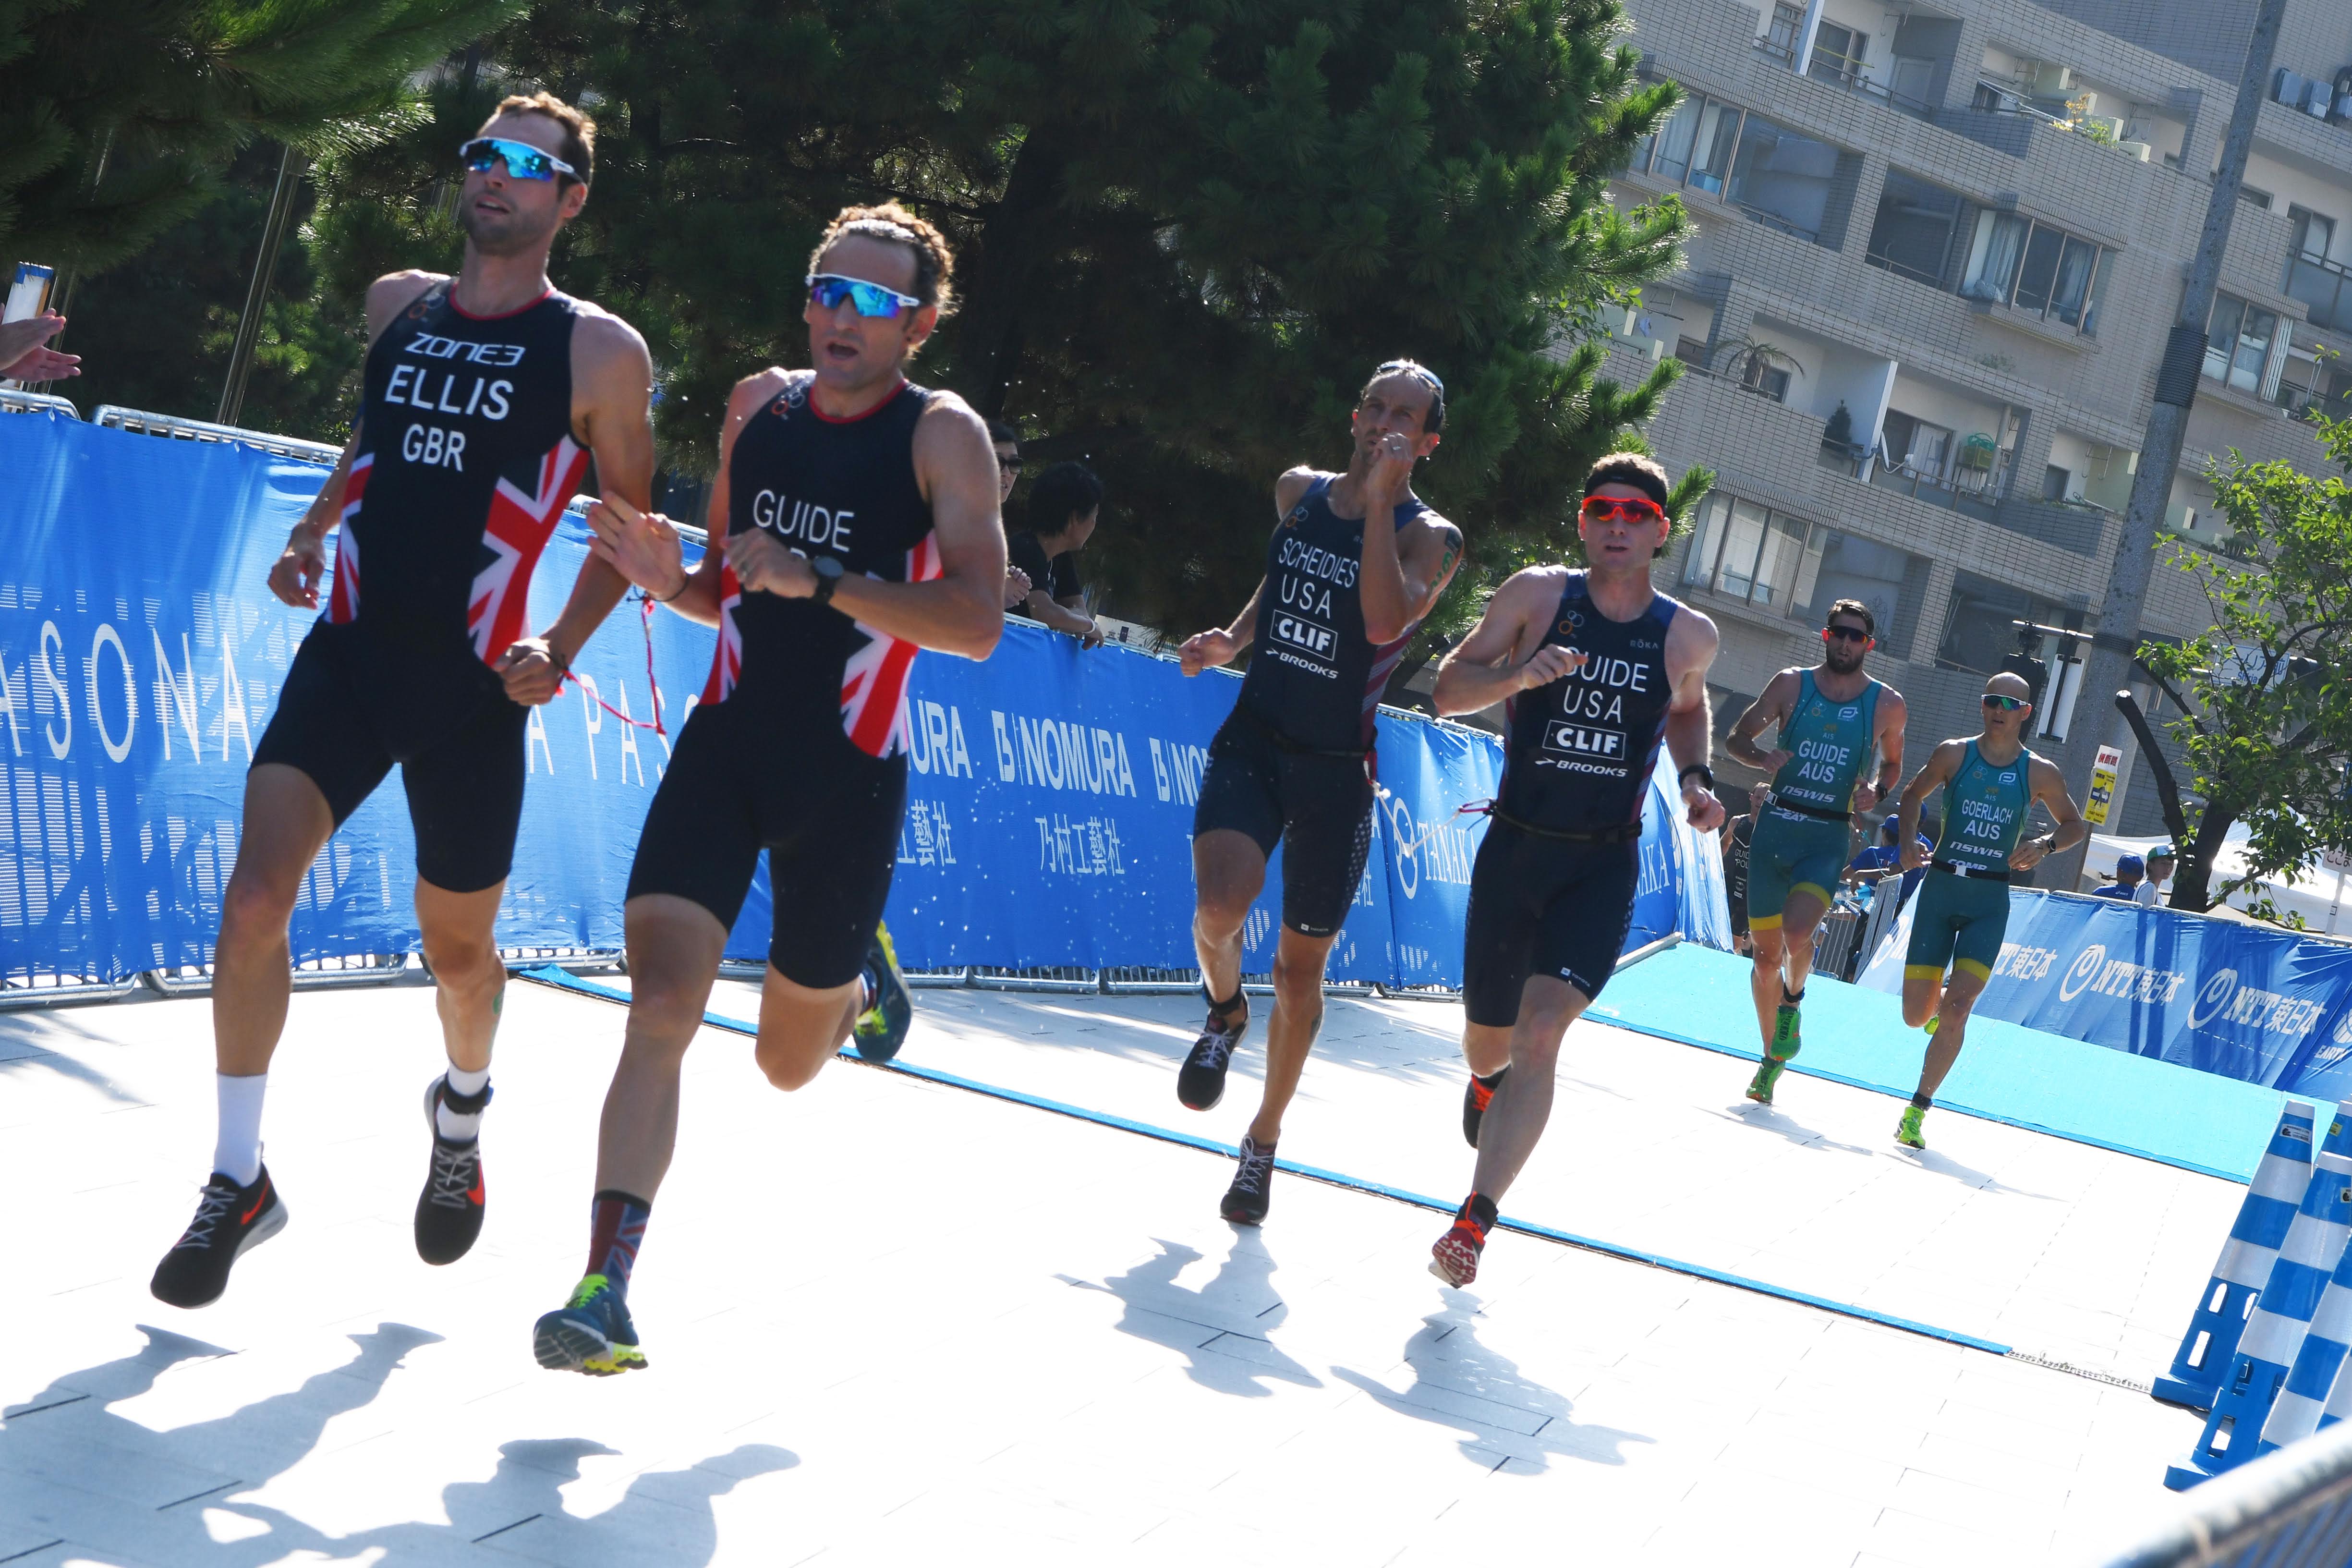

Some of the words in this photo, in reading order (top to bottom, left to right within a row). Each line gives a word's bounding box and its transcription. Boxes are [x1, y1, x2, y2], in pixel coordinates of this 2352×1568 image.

[385, 364, 514, 420] ELLIS
[402, 423, 466, 472] GBR
[753, 489, 855, 552] GUIDE
[1278, 537, 1359, 588] SCHEIDIES
[1281, 574, 1331, 620] USA
[1278, 618, 1332, 652] CLIF
[1279, 652, 1339, 680] BROOKS
[1564, 685, 1621, 723] USA
[906, 696, 973, 779] URA
[1556, 728, 1618, 754] CLIF
[1798, 740, 1850, 766] GUIDE
[1557, 760, 1628, 777] BROOKS
[1797, 761, 1836, 784] AUS
[1962, 799, 2013, 824] GOERLACH
[1963, 819, 2001, 840] AUS
[1035, 813, 1126, 876] 乃村工藝社
